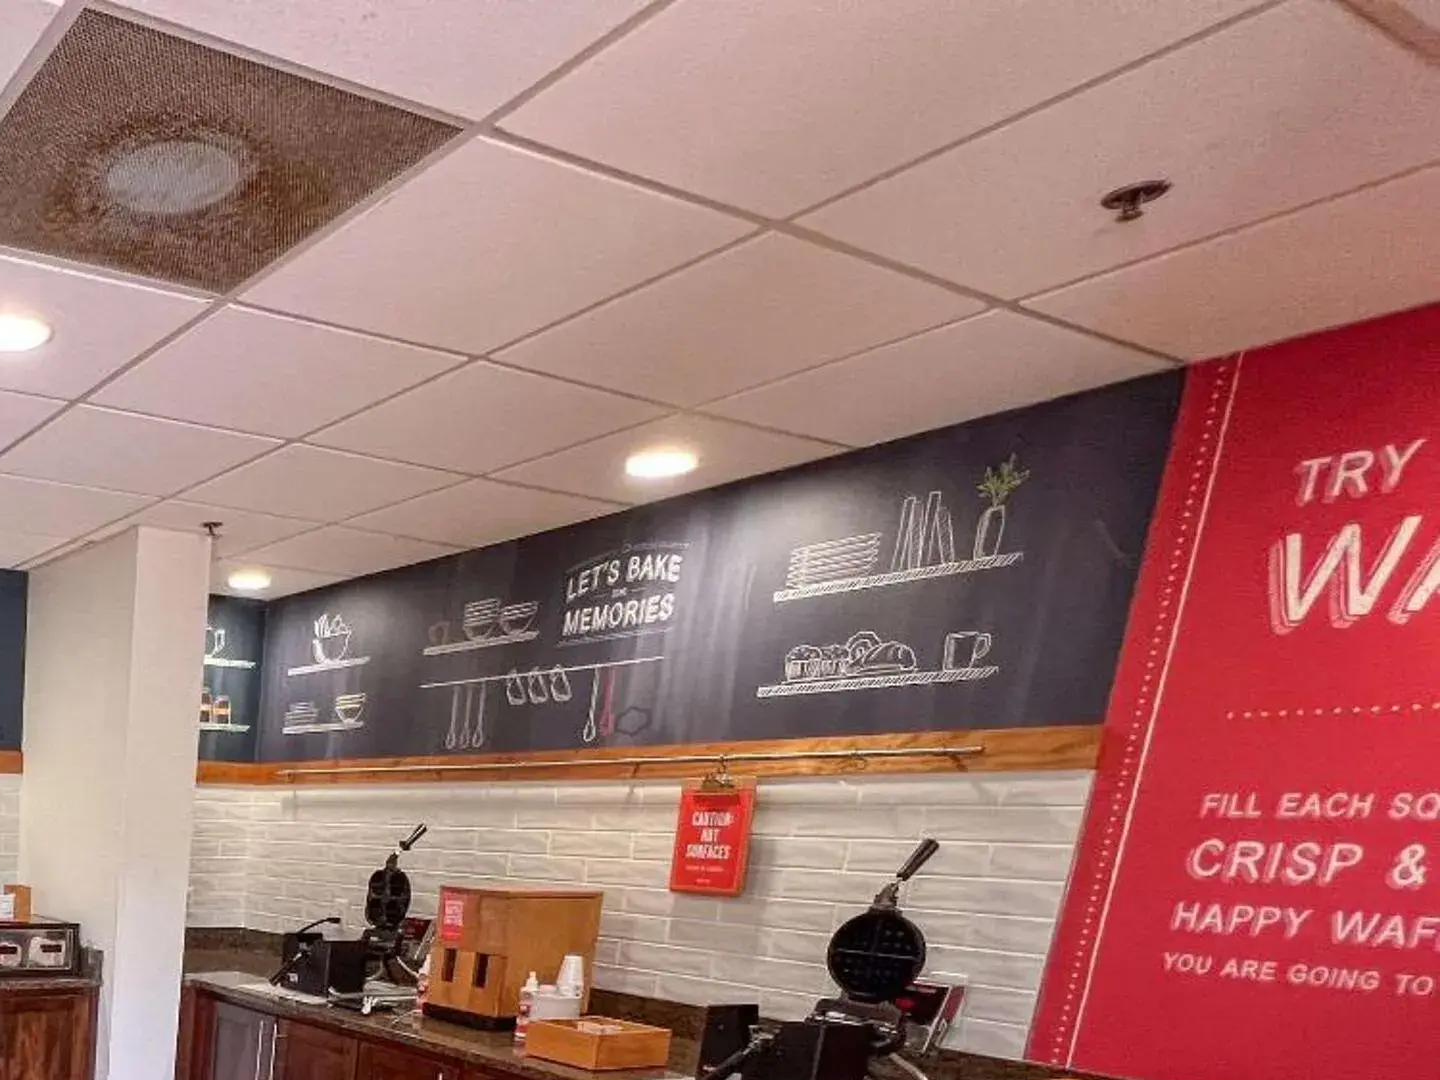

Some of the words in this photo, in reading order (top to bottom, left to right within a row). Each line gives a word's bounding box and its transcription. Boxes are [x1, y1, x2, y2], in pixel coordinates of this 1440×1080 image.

[1293, 438, 1427, 507] TRY
[565, 560, 620, 602] LET'S
[626, 554, 682, 583] BAKE
[562, 593, 676, 636] MEMORIES
[1199, 792, 1262, 819] FILL
[1276, 792, 1375, 819] EACH
[1186, 838, 1364, 887] CRISP
[1385, 843, 1428, 892] &
[1170, 901, 1315, 940] HAPPY
[1163, 952, 1213, 976] YOU
[1219, 957, 1278, 982] ARE
[1287, 963, 1381, 992] GOING
[1395, 973, 1434, 996] TO
